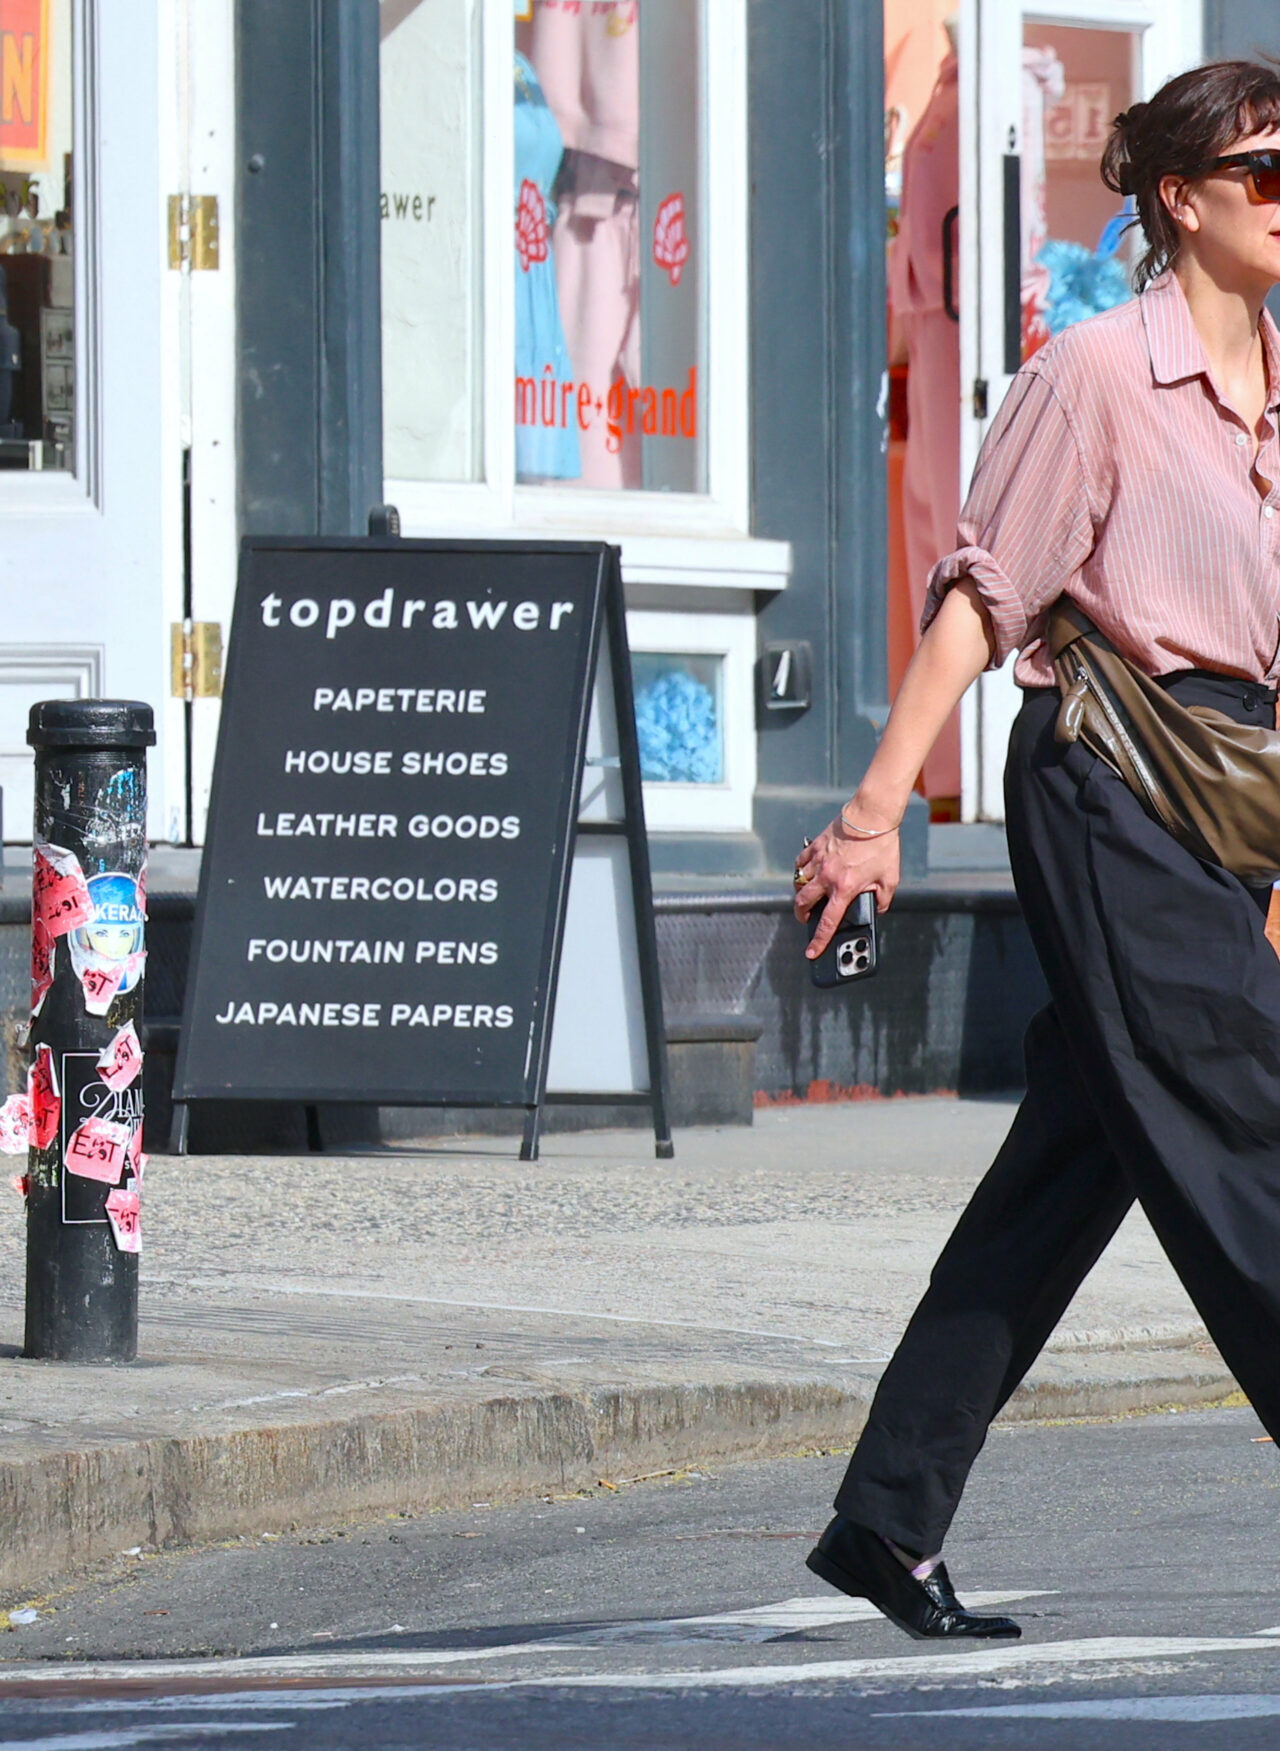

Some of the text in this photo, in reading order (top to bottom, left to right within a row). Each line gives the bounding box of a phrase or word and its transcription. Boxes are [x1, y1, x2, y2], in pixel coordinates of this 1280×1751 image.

[261, 588, 573, 639] topdrawer
[314, 688, 486, 713] PAPETERIE
[285, 751, 508, 775] HOUSE SHOES
[257, 813, 520, 839] LEATHER GOODS
[264, 877, 498, 902] WATERCOLORS
[248, 939, 498, 964] FOUNTAIN PENS
[216, 1002, 513, 1028] JAPANESE PAPERS
